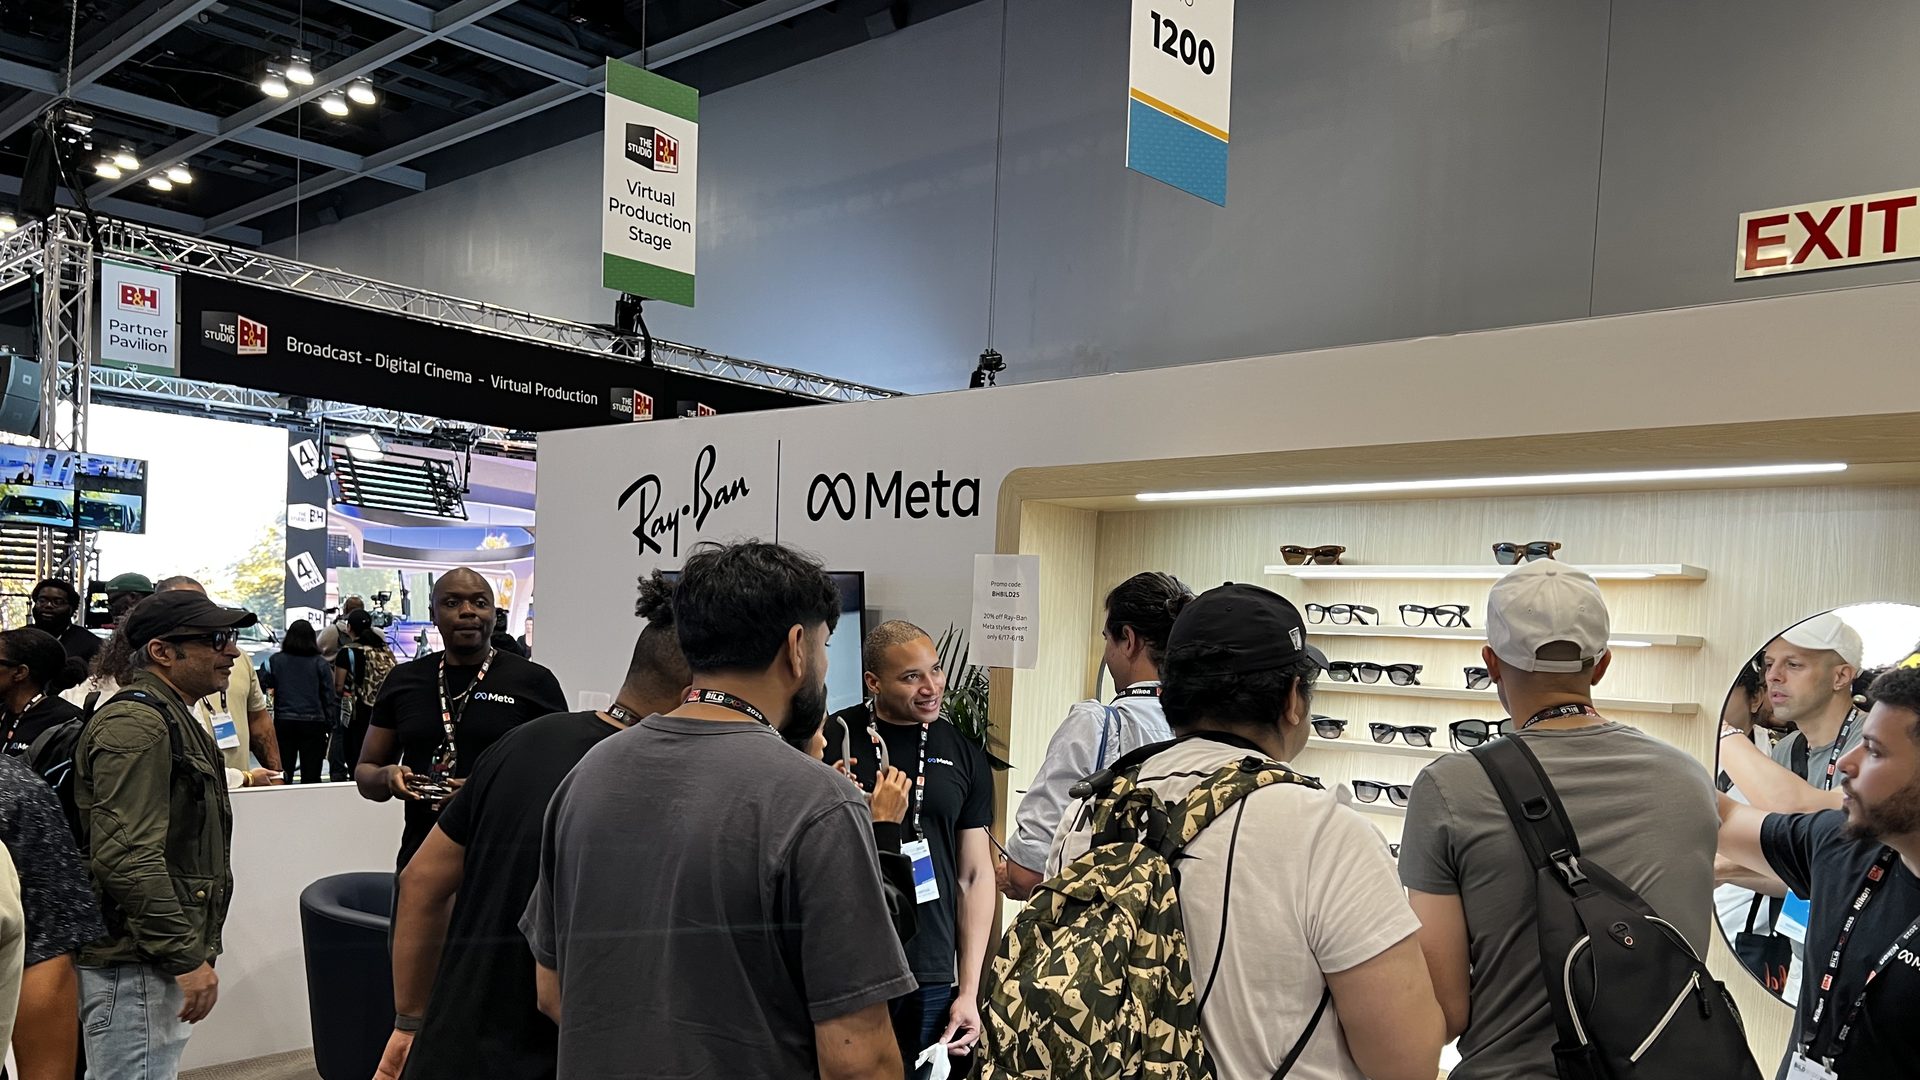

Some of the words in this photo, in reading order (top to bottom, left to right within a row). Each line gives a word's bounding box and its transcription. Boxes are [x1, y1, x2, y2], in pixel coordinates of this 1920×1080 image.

[1150, 10, 1215, 75] 1200
[627, 142, 653, 159] STUDIO
[639, 137, 653, 149] THE
[655, 133, 678, 166] B&H
[626, 178, 675, 207] Virtual
[609, 196, 691, 234] Production
[629, 225, 672, 251] Stage
[1744, 195, 1917, 271] EXIT
[121, 284, 157, 309] B&H
[109, 319, 169, 338] Partner
[204, 330, 236, 344] STUDIO
[219, 323, 236, 335] THE
[239, 319, 266, 348] B&H
[109, 334, 168, 354] Pavilion
[286, 336, 362, 364] Broadcast
[375, 353, 420, 374] Digital
[424, 362, 472, 384] Cinema
[490, 374, 532, 395] Virtual
[535, 383, 598, 405] Production
[612, 402, 633, 414] STUDIO
[621, 397, 633, 405] THE
[299, 445, 314, 467] 4
[865, 469, 981, 520] Meta
[297, 557, 313, 580] 4
[990, 580, 1007, 588] Promo
[991, 590, 1020, 598] BHBILD25
[983, 612, 995, 620] 20%
[995, 612, 1004, 620] off
[1003, 613, 1028, 621] Ray-Ban
[995, 624, 1011, 632] styles
[487, 692, 515, 705] Meta
[705, 690, 725, 703] BILD
[746, 706, 763, 720] 2025
[1853, 887, 1871, 911] Nikon
[1902, 924, 1919, 940] 2025
[1879, 943, 1900, 966] Nikon
[1813, 997, 1825, 1023] Nikon
